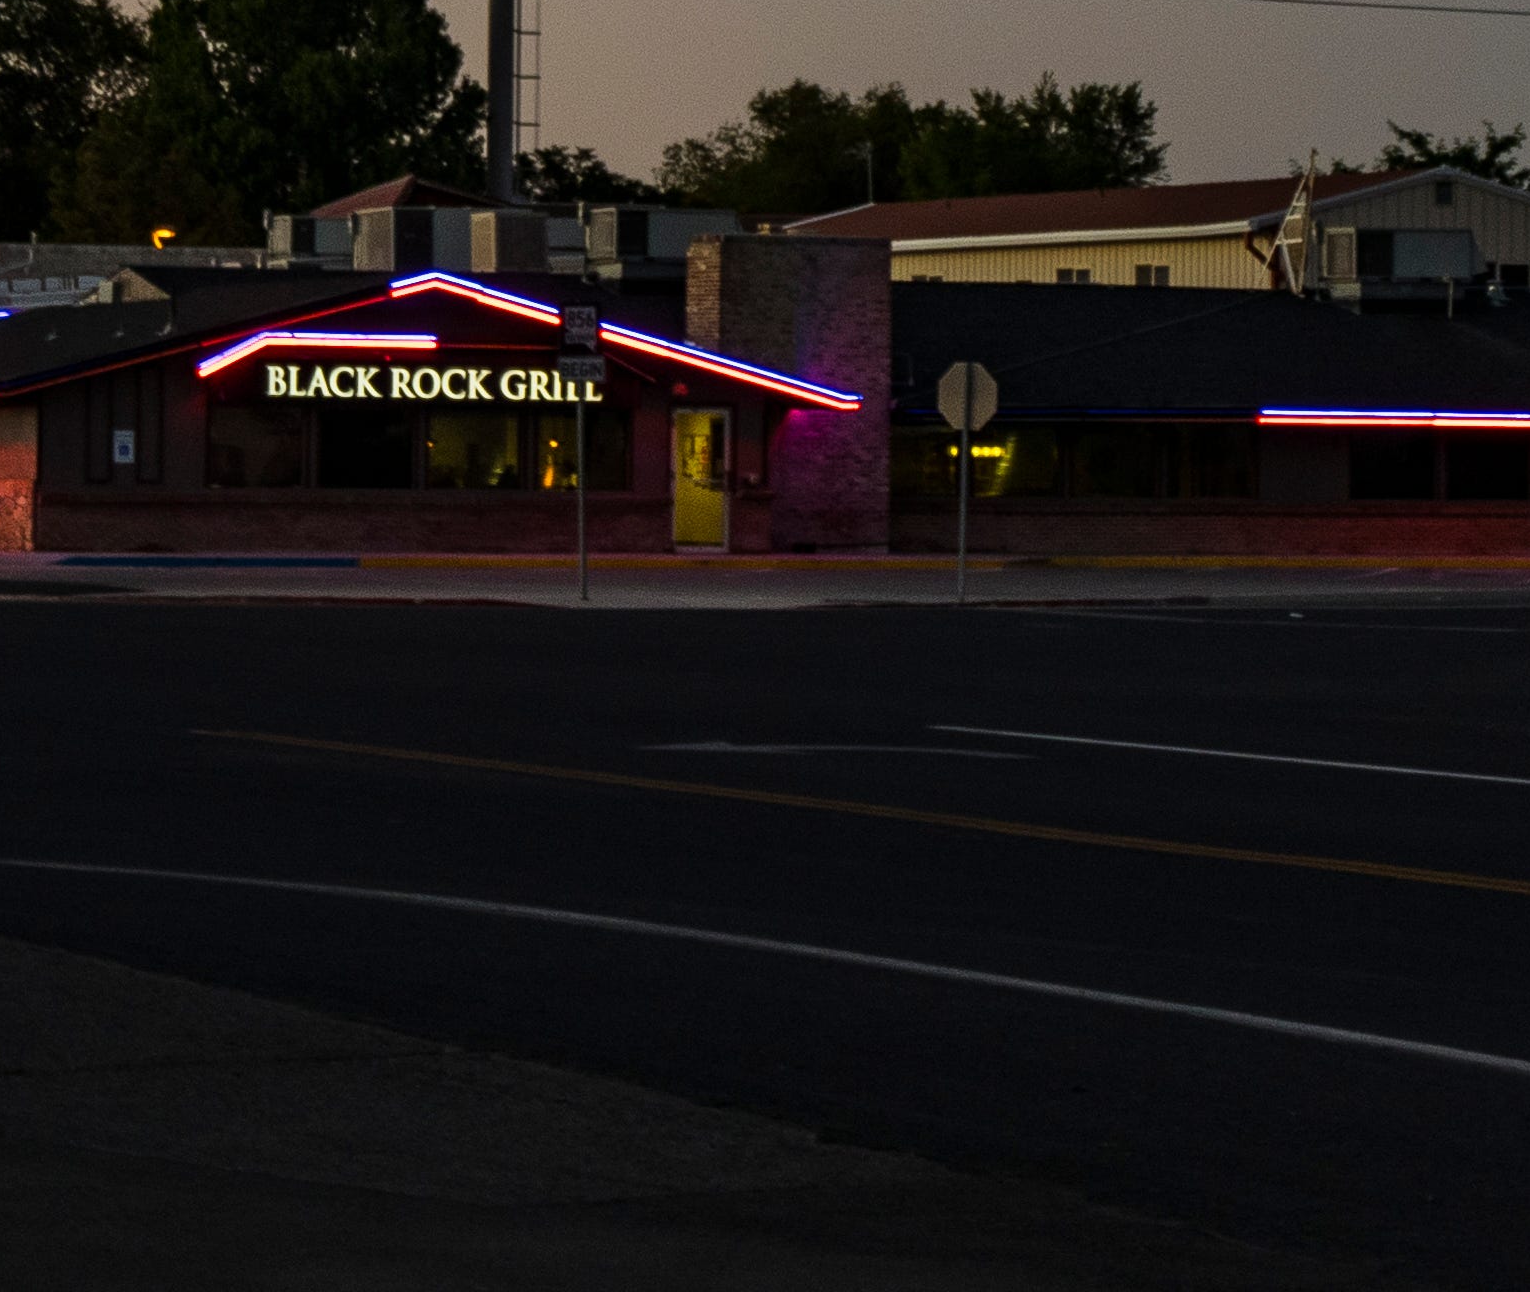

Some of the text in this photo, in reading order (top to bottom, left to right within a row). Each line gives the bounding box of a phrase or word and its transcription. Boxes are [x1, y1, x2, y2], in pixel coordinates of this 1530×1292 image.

[561, 361, 603, 377] BEGIN
[266, 365, 383, 398] BLACK
[390, 367, 495, 401] ROCK
